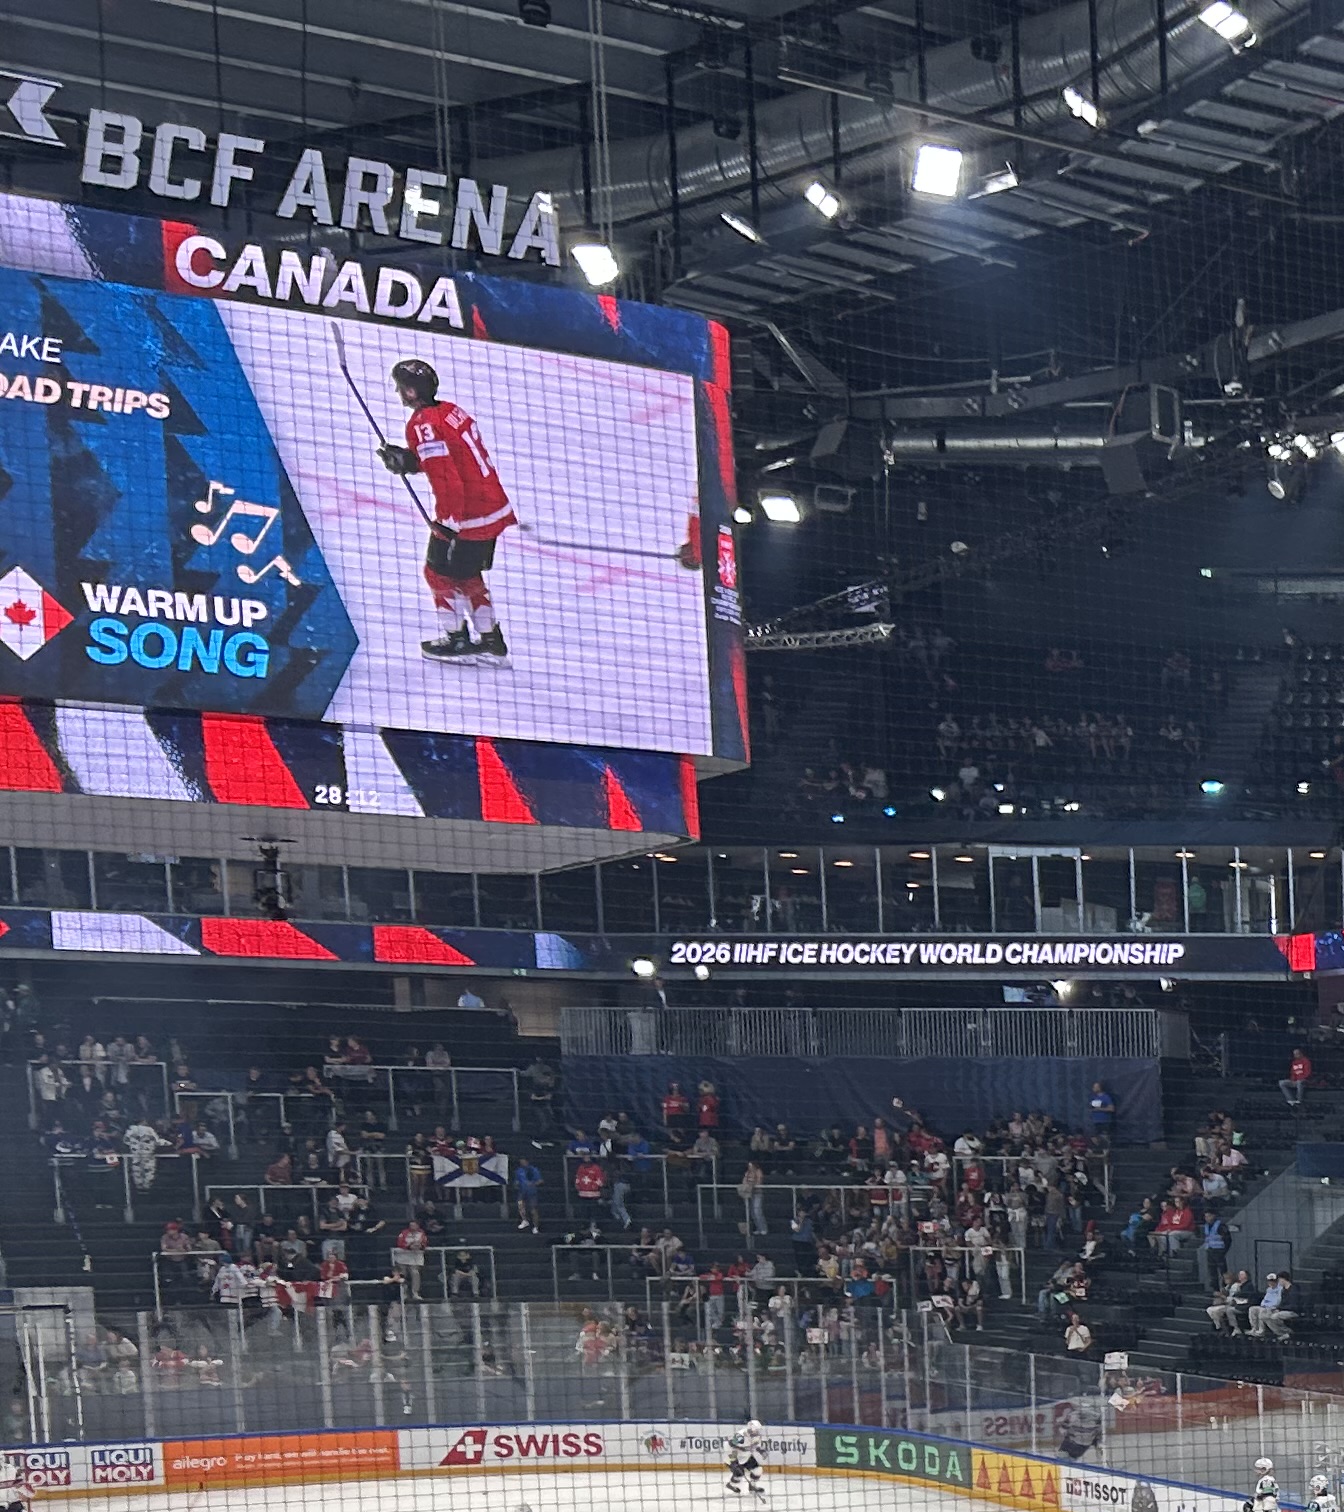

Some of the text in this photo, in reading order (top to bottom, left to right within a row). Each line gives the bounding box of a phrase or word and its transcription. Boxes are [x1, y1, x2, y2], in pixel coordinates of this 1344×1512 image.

[82, 107, 562, 267] BCF ARENA
[175, 236, 464, 328] CANADA
[67, 381, 170, 419] TRIPS
[81, 582, 267, 628] WARM UP
[86, 618, 270, 678] SONG
[670, 943, 1184, 966] 2026 IIHF ICE HOCKEY WORLD CHAMPIONSHIP
[93, 1448, 151, 1466] LIQUI
[494, 1433, 603, 1457] SWISS
[94, 1465, 152, 1482] MOLY
[1083, 1480, 1127, 1505] TISSOT
